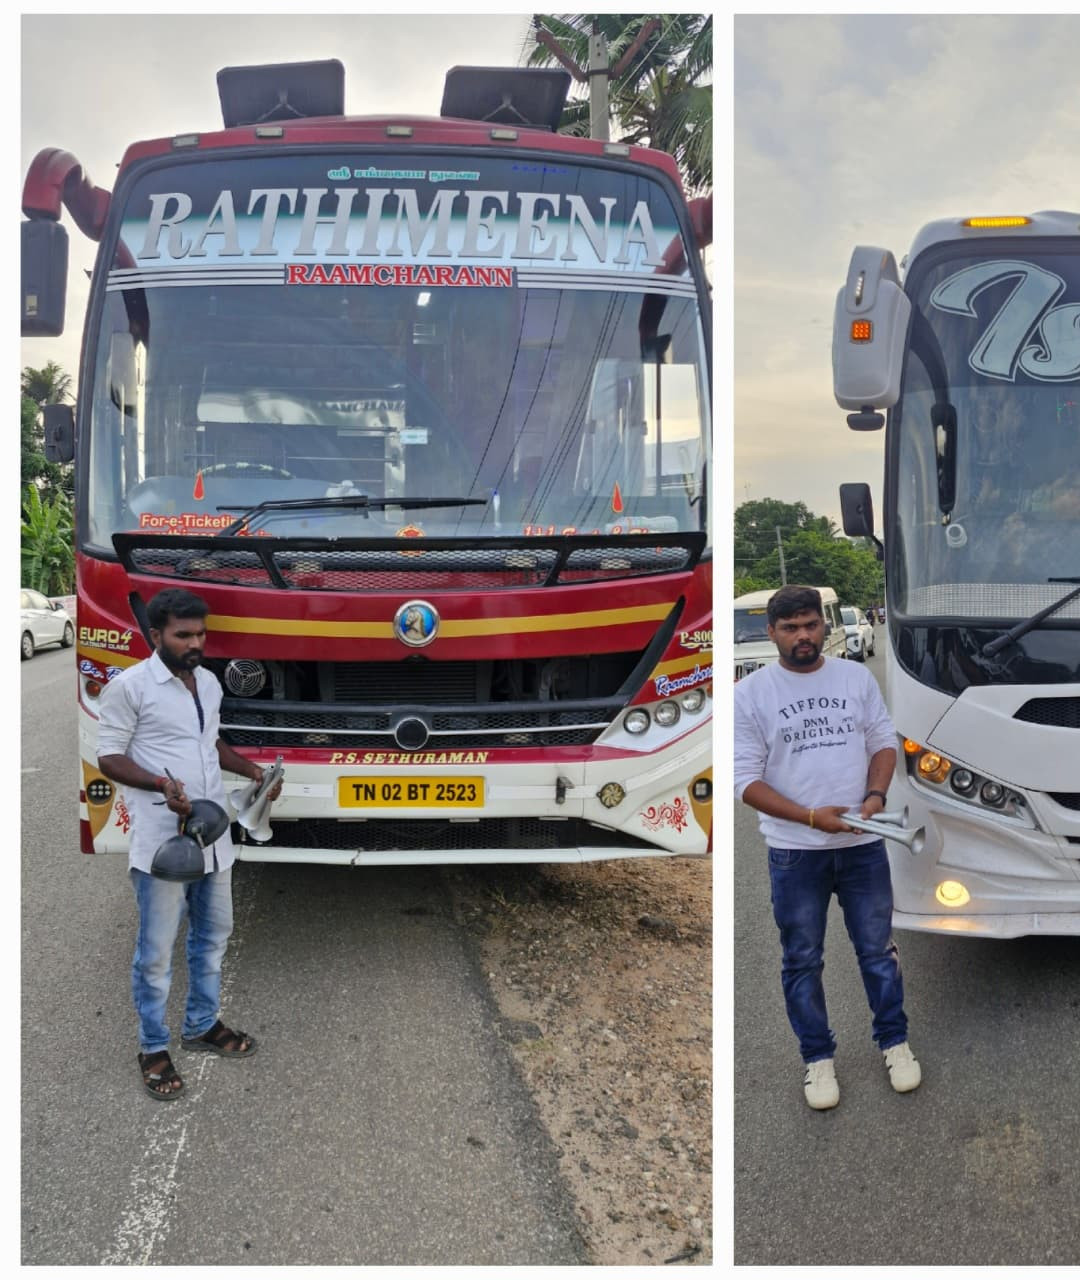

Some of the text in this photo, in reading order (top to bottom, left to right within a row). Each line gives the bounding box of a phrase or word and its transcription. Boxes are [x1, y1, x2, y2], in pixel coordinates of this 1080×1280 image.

[136, 187, 667, 268] RATHIMEENA
[286, 264, 515, 288] RAAMCHARANN
[80, 627, 132, 644] EURO 4
[778, 696, 847, 720] TIFFOSI
[803, 716, 829, 728] DNM
[783, 723, 855, 744] ORIGINAL
[329, 752, 488, 764] P.S.SETHURAMAN
[353, 784, 476, 801] TN 02 BT 2523
